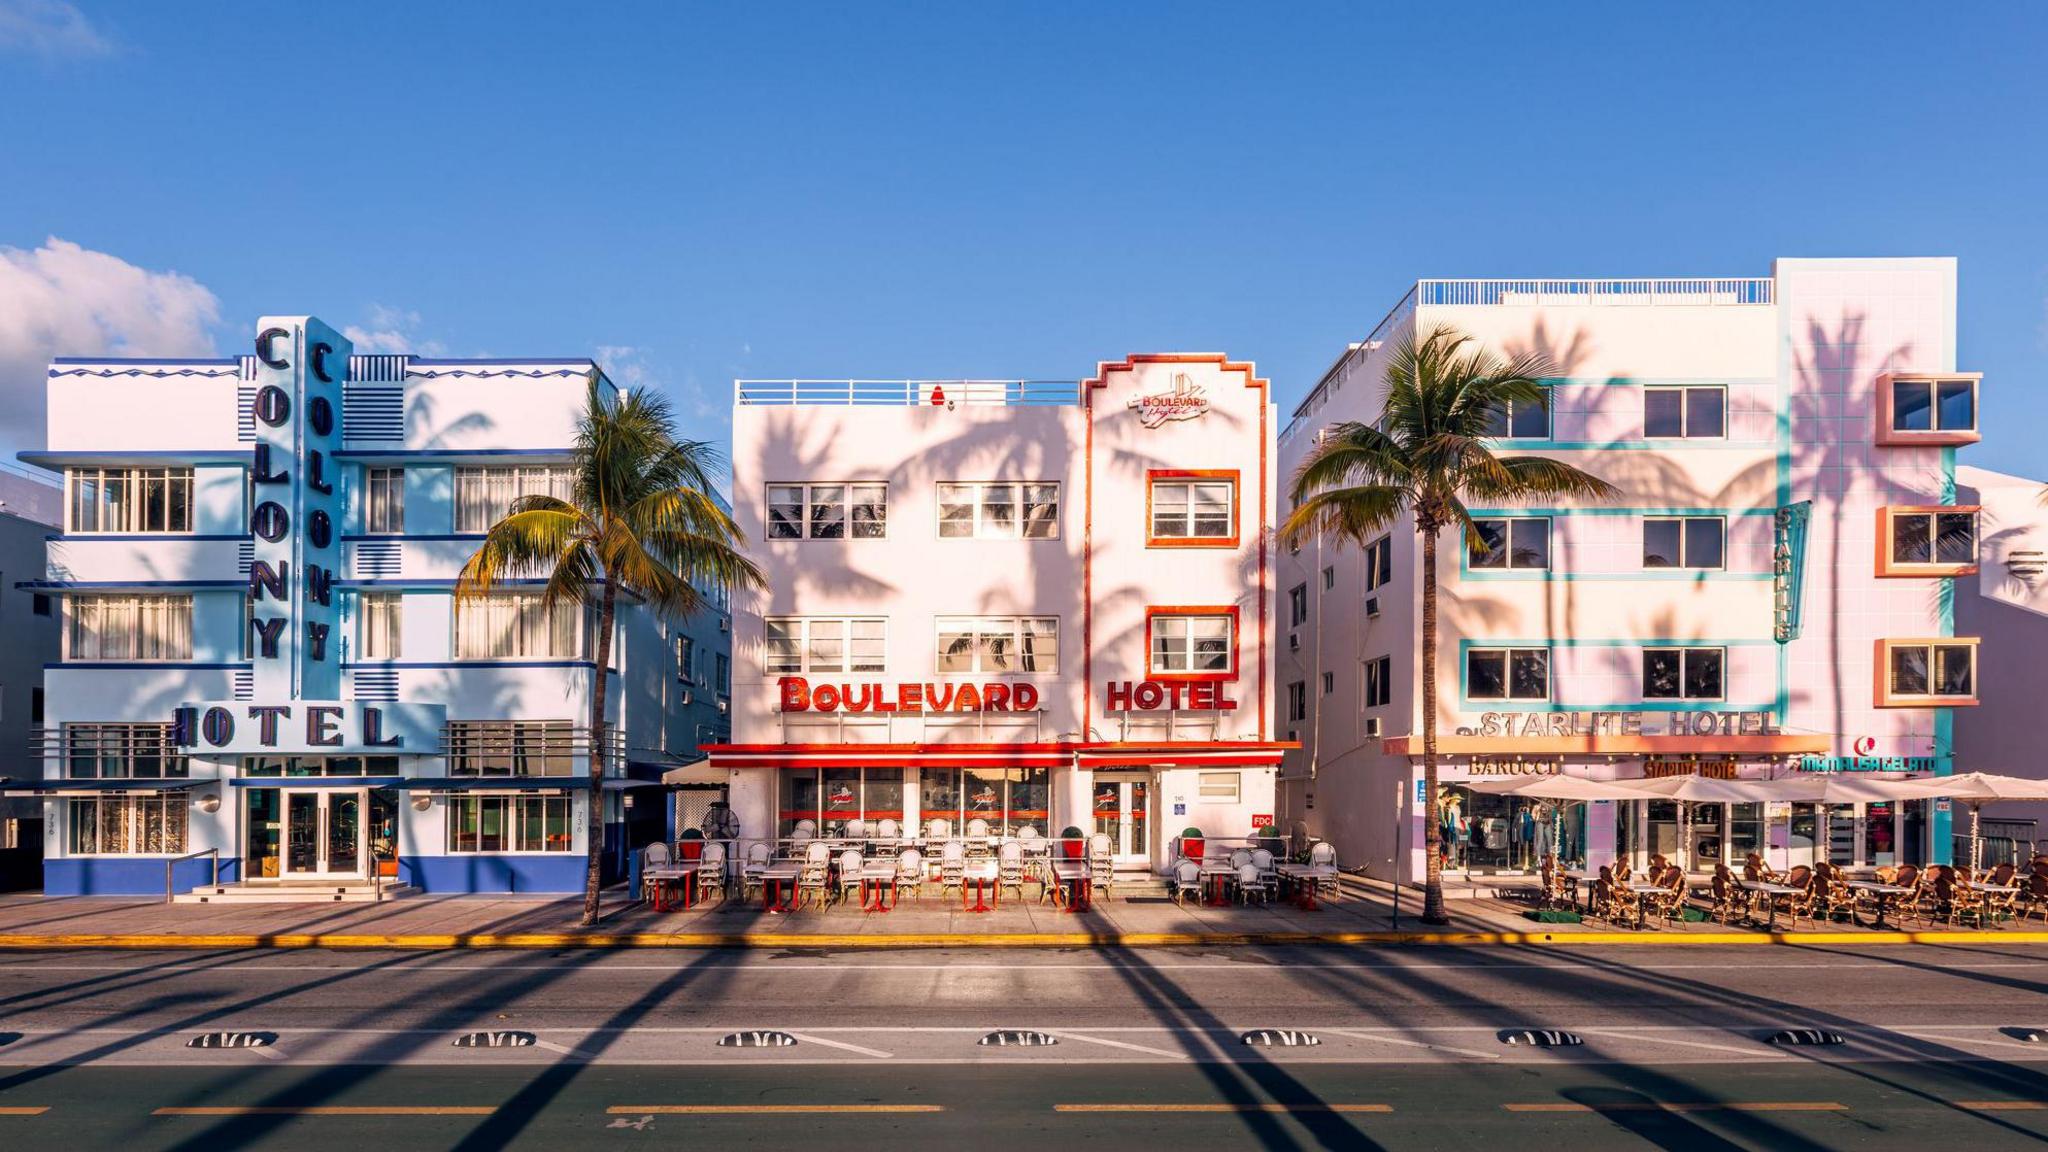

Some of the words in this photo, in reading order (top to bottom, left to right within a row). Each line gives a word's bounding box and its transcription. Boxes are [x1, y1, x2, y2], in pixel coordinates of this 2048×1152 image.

[1143, 397, 1208, 407] BOULEVARD
[252, 327, 291, 660] COLONY
[306, 341, 334, 661] COLONY
[777, 676, 1039, 712] BOULEVARD
[1106, 680, 1238, 711] HOTEL
[1481, 711, 1642, 736] STARLITE
[1669, 711, 1781, 736] HOTEL
[1468, 759, 1559, 776] BARUCCI
[1254, 817, 1271, 826] FDC
